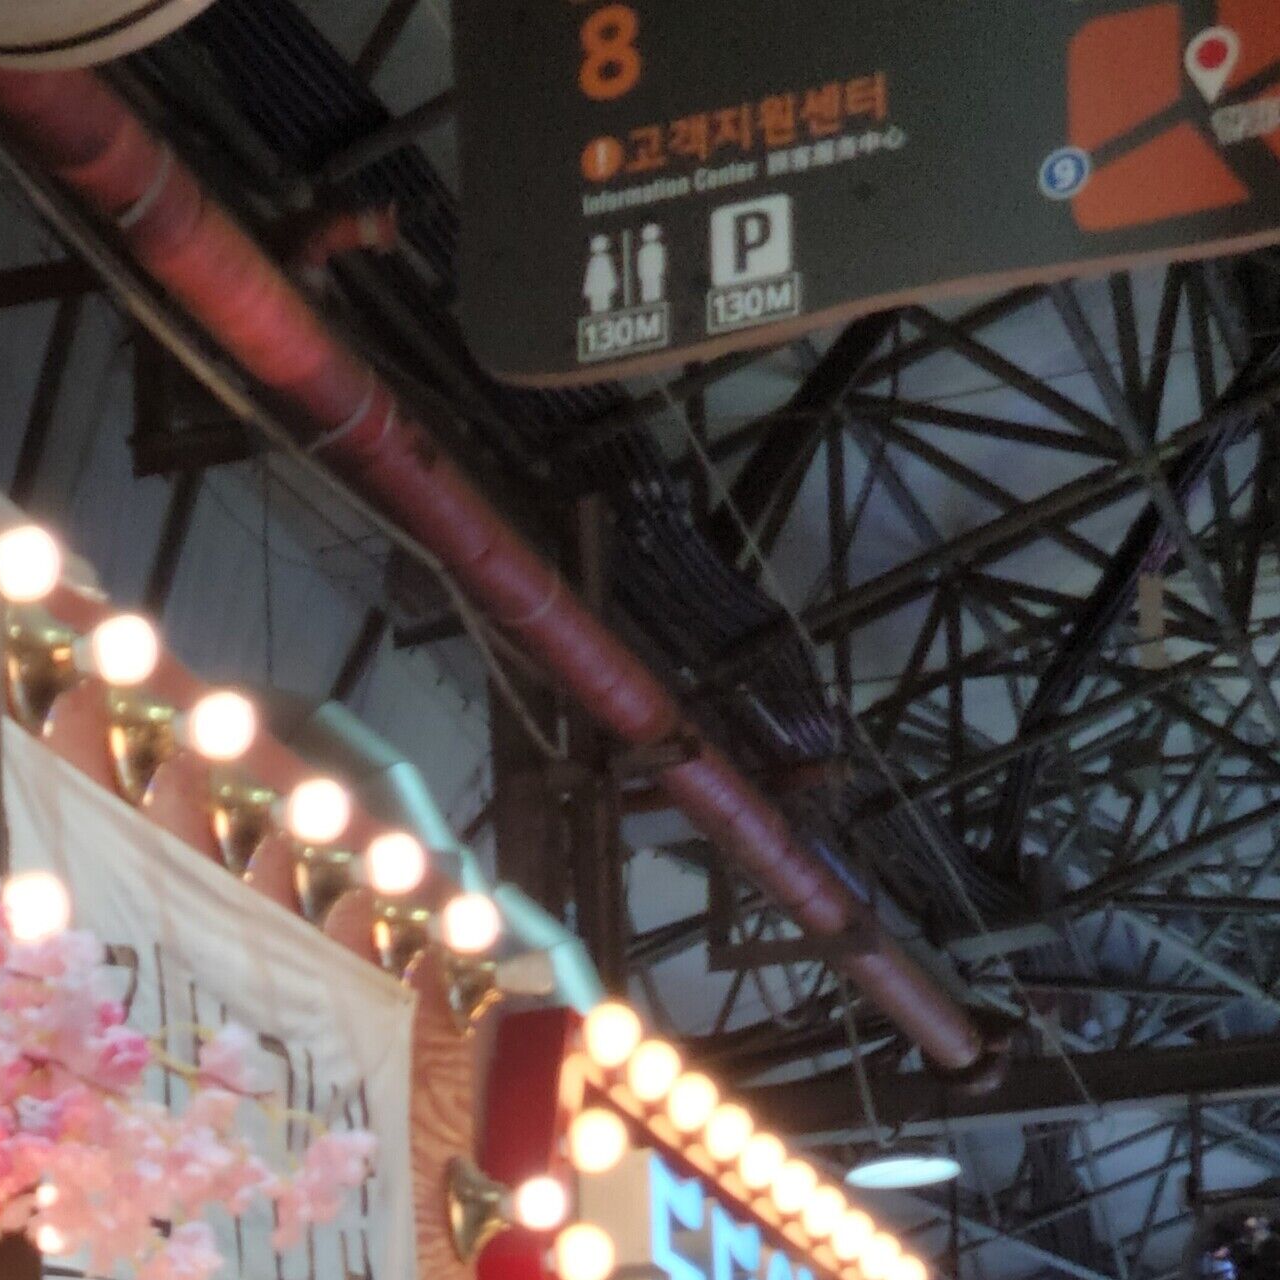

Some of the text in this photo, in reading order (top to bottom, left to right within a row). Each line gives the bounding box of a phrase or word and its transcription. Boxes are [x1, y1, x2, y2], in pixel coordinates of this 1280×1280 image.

[578, 4, 639, 100] 8
[625, 71, 888, 173] 고객지원센터
[582, 161, 758, 216] Information Center
